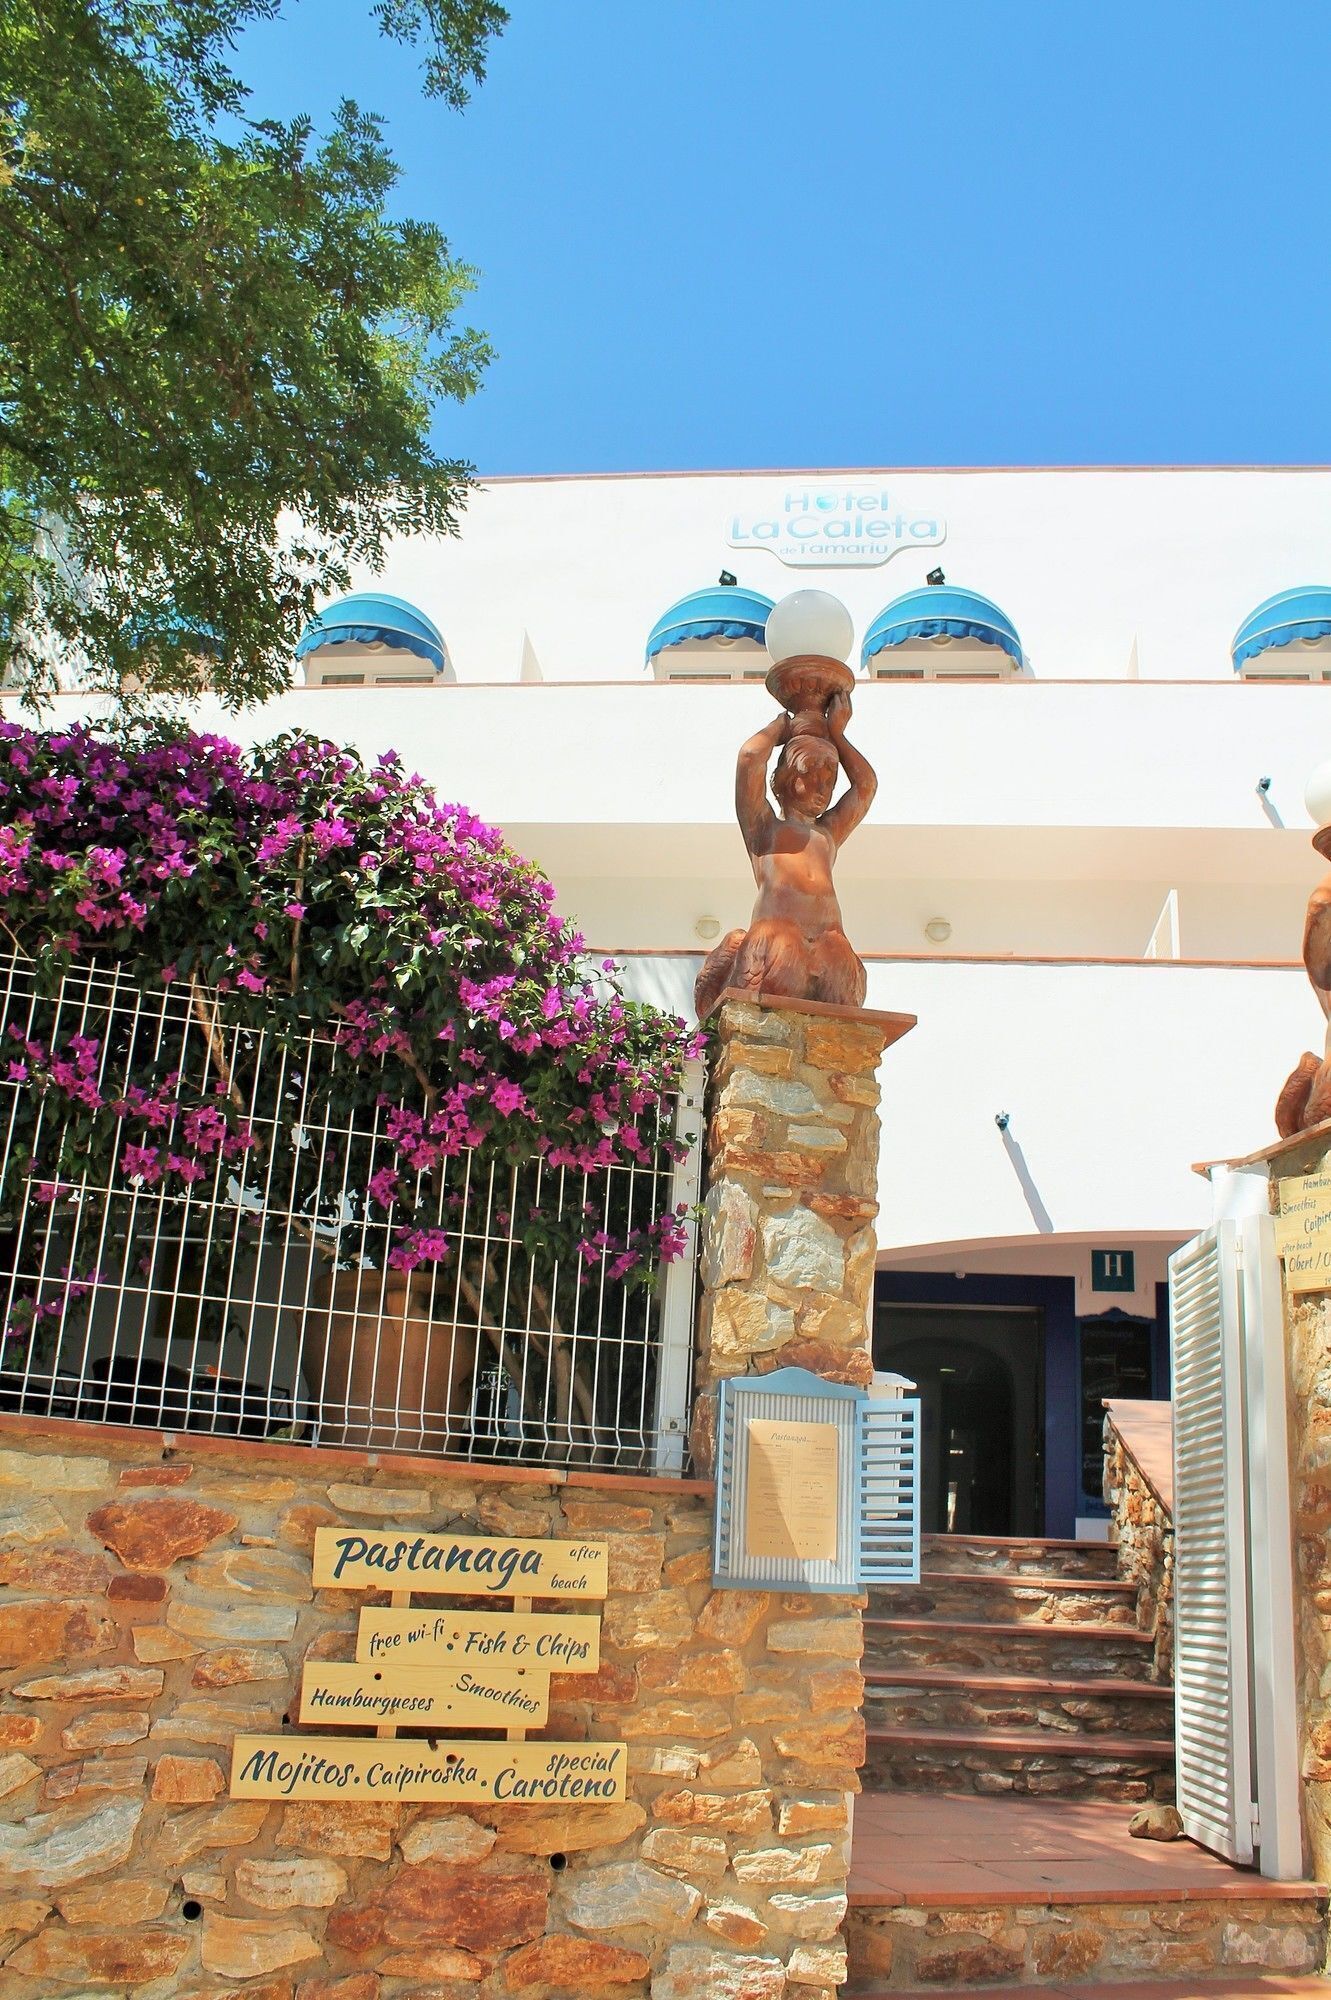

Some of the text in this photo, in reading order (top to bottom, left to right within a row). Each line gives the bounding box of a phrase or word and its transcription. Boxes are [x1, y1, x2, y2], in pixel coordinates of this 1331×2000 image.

[784, 491, 888, 513] Hotel
[731, 514, 938, 540] La Caleta
[799, 543, 888, 554] Tamariu
[1104, 1254, 1123, 1277] H
[1289, 1254, 1313, 1273] Obert
[333, 1536, 543, 1591] Pastanaga
[569, 1545, 602, 1561] after
[550, 1574, 588, 1590] beach
[369, 1618, 590, 1663] free wi-fi Fish & Chips
[310, 1688, 434, 1716] Hamburgueses
[456, 1673, 540, 1714] Smoothies
[546, 1748, 621, 1773] special
[494, 1768, 617, 1799] Caroteno
